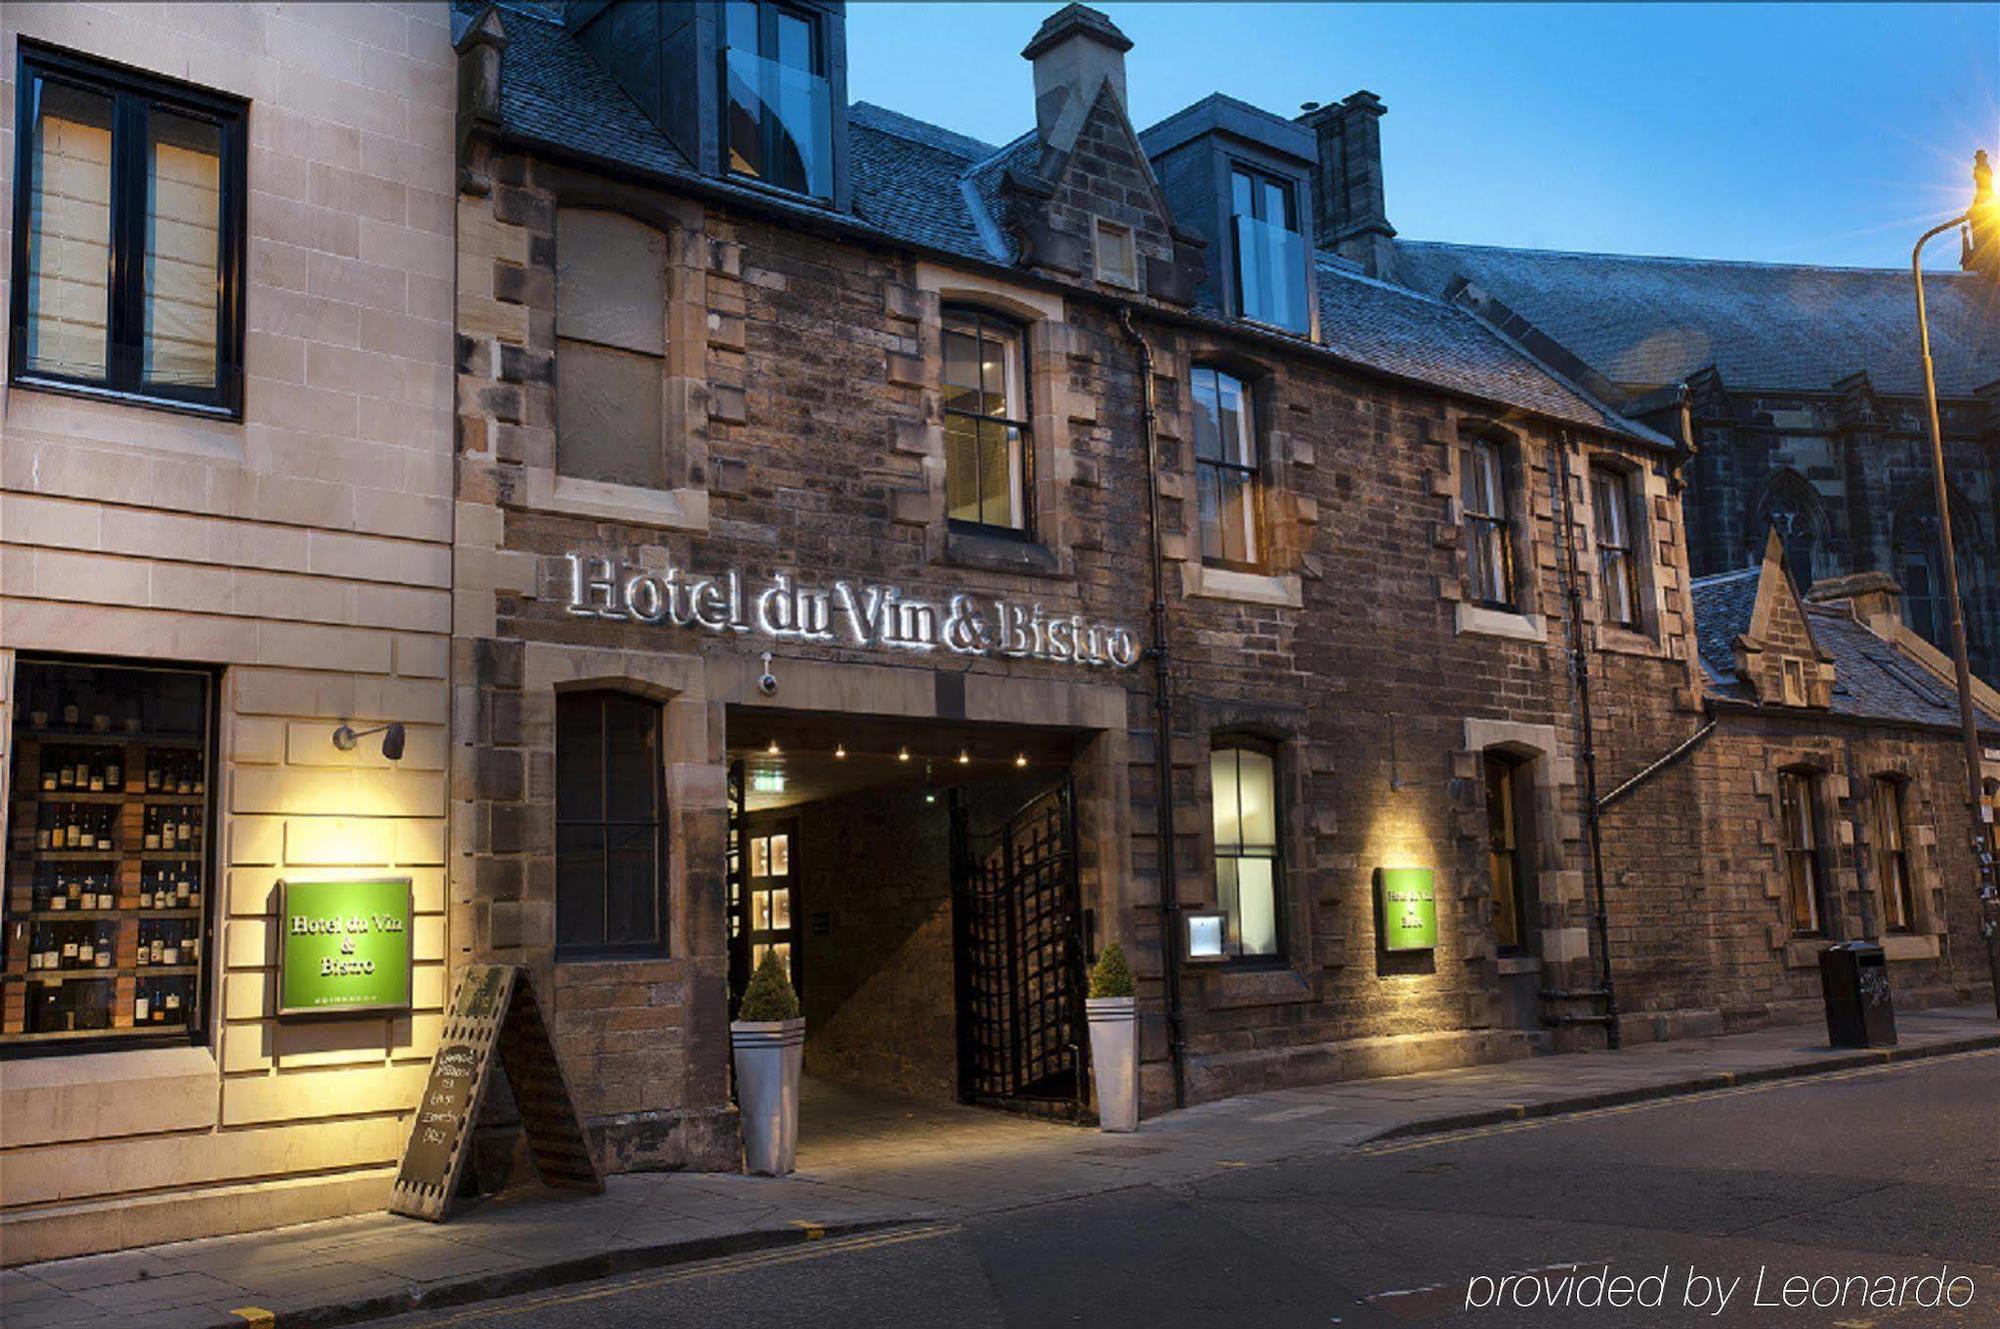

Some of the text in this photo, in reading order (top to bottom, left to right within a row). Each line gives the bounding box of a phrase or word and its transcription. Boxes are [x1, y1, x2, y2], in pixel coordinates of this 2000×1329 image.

[565, 552, 1141, 667] Hotel du Vin & Bistro
[291, 914, 402, 936] Hotel du Vin
[340, 936, 356, 954] &
[320, 957, 375, 976] Bistro
